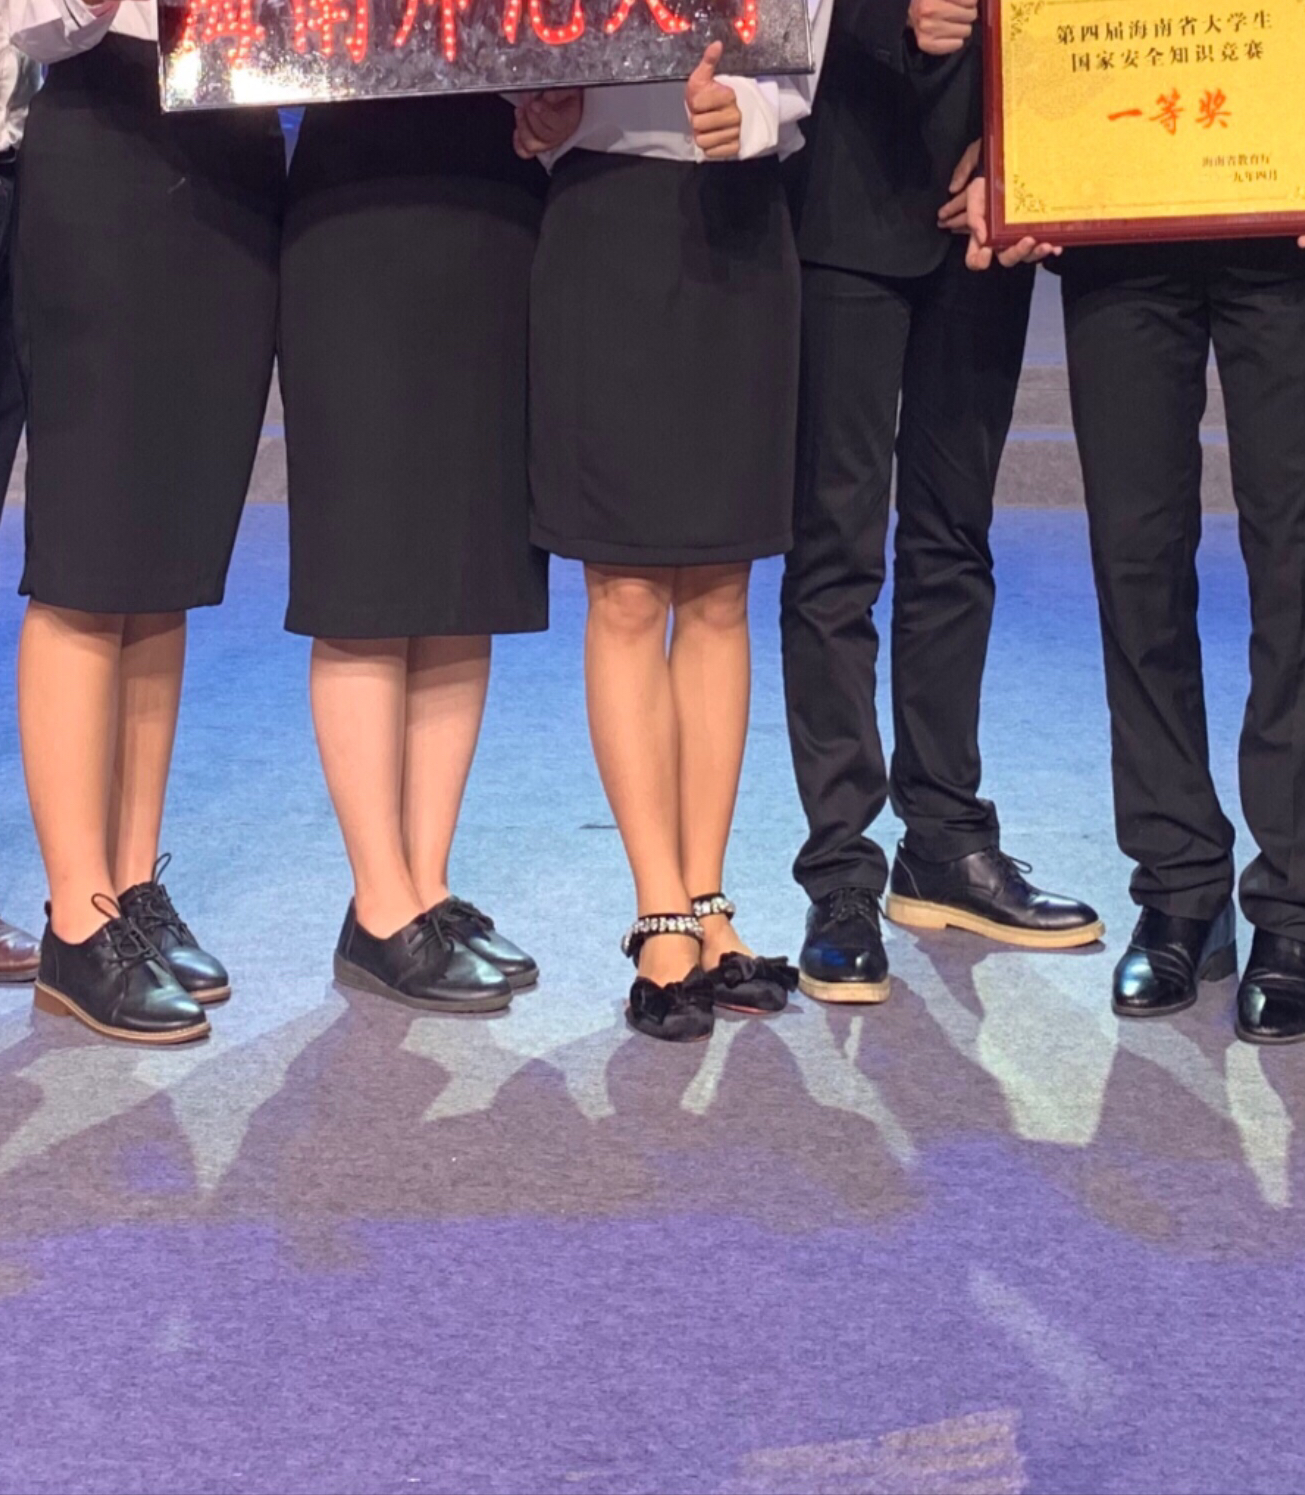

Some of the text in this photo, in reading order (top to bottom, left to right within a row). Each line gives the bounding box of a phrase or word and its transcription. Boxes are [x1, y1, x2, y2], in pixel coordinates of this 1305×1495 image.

[1056, 10, 1273, 45] 第四届海南省大学生
[1071, 40, 1265, 73] 国家安全知识竞赛
[1107, 86, 1233, 135] 一等奖
